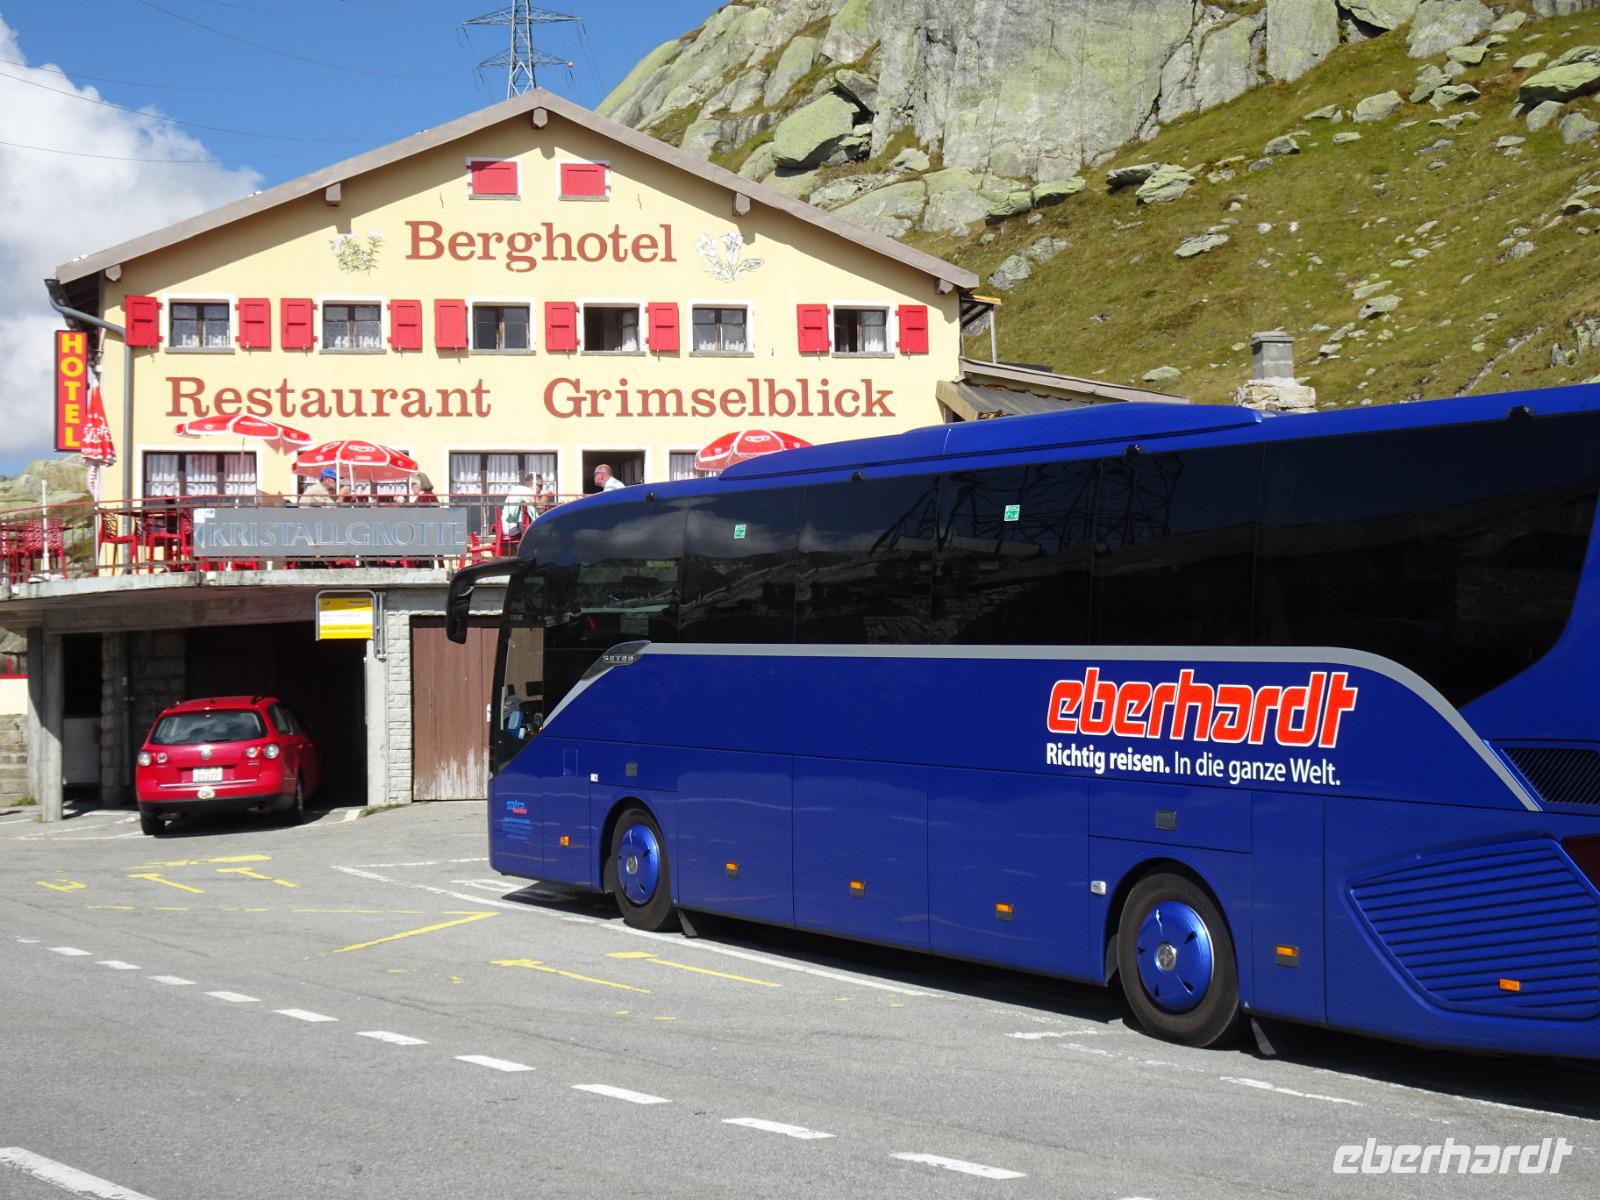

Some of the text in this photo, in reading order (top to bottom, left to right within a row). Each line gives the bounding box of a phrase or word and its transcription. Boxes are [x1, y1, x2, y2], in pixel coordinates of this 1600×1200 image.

[405, 222, 675, 272] Berghotel
[61, 333, 84, 447] HOTEL
[165, 376, 895, 418] Restaurant Grimselblick
[208, 521, 466, 547] KRISTALLGROTTE
[1047, 667, 1358, 748] eberhardt
[1046, 743, 1340, 785] Richtig reisen. In die ganze Welt.
